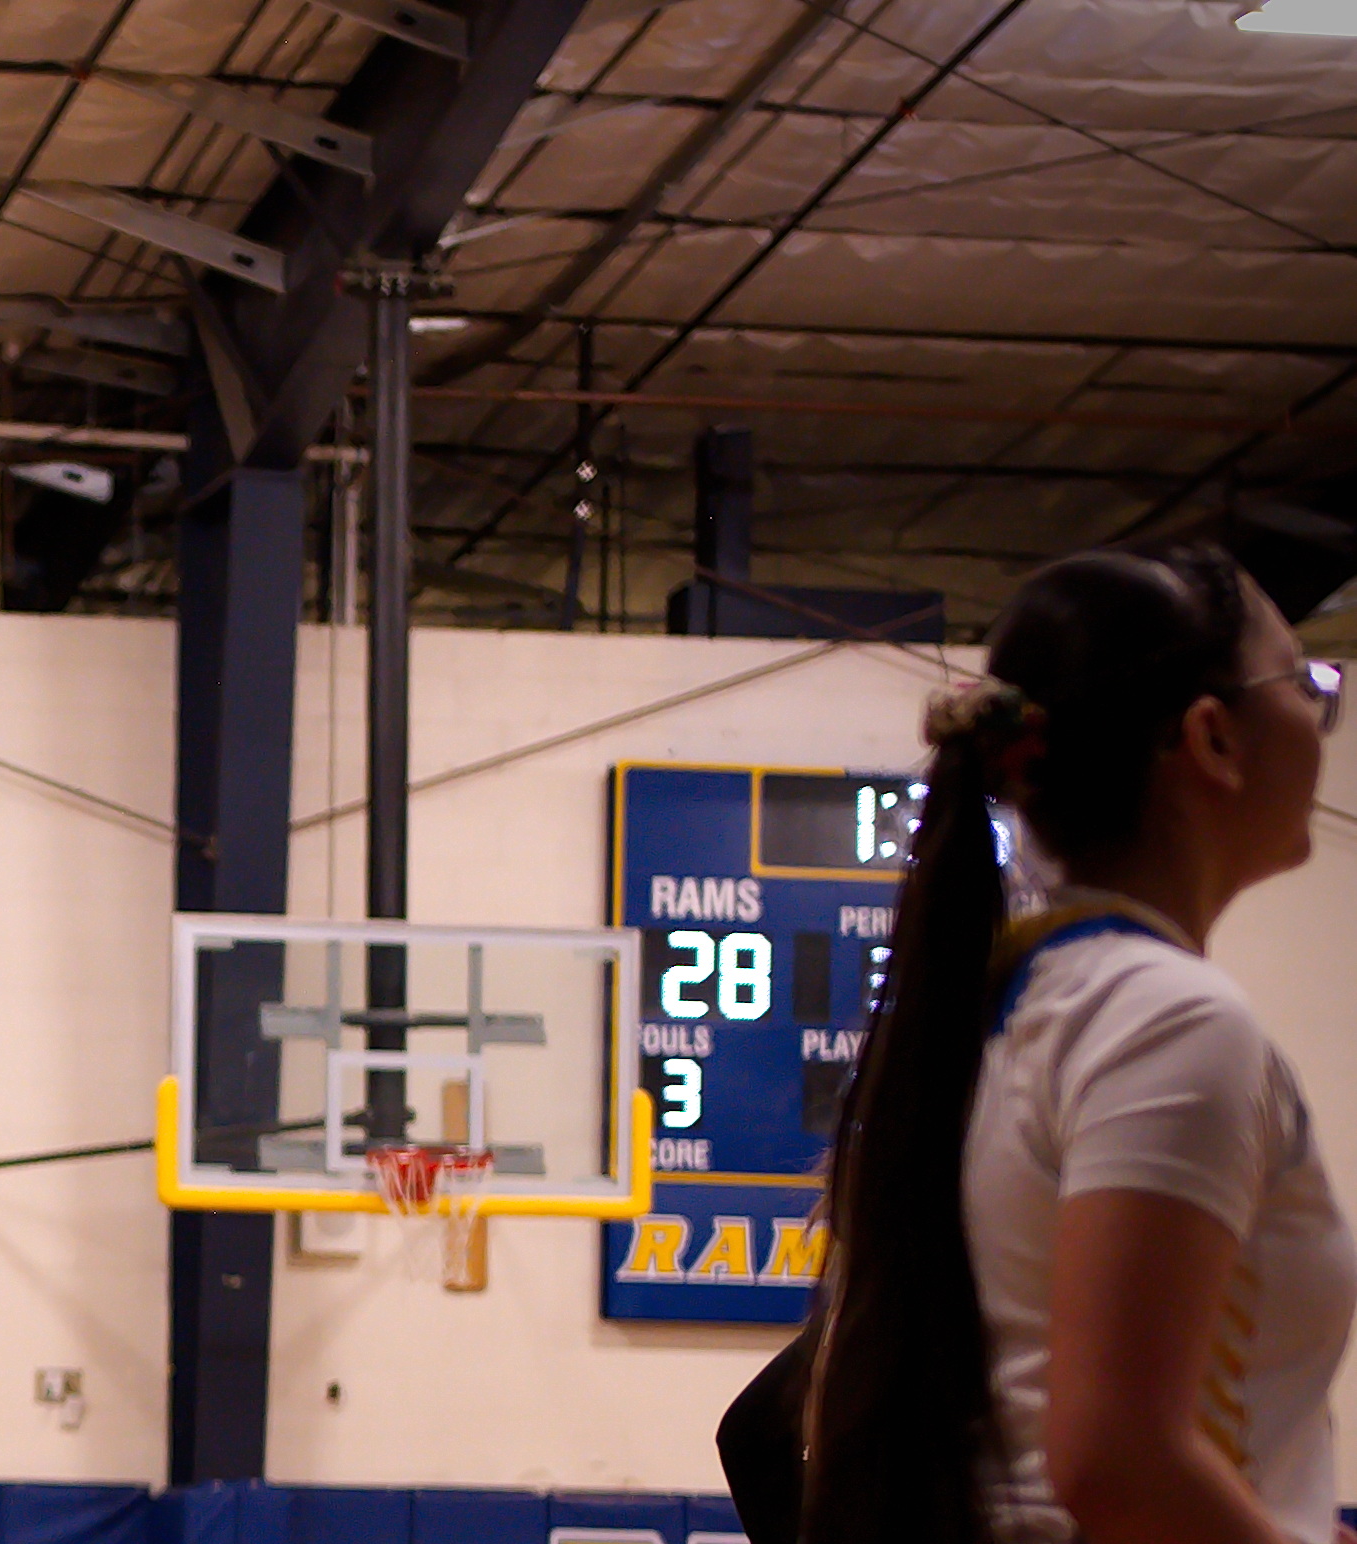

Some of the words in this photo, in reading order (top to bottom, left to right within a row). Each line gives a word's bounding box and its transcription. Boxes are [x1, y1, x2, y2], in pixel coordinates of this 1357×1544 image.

[651, 877, 761, 922] RAMS
[661, 930, 771, 1021] 28
[638, 1023, 712, 1057] OULS
[662, 1058, 702, 1129] 3
